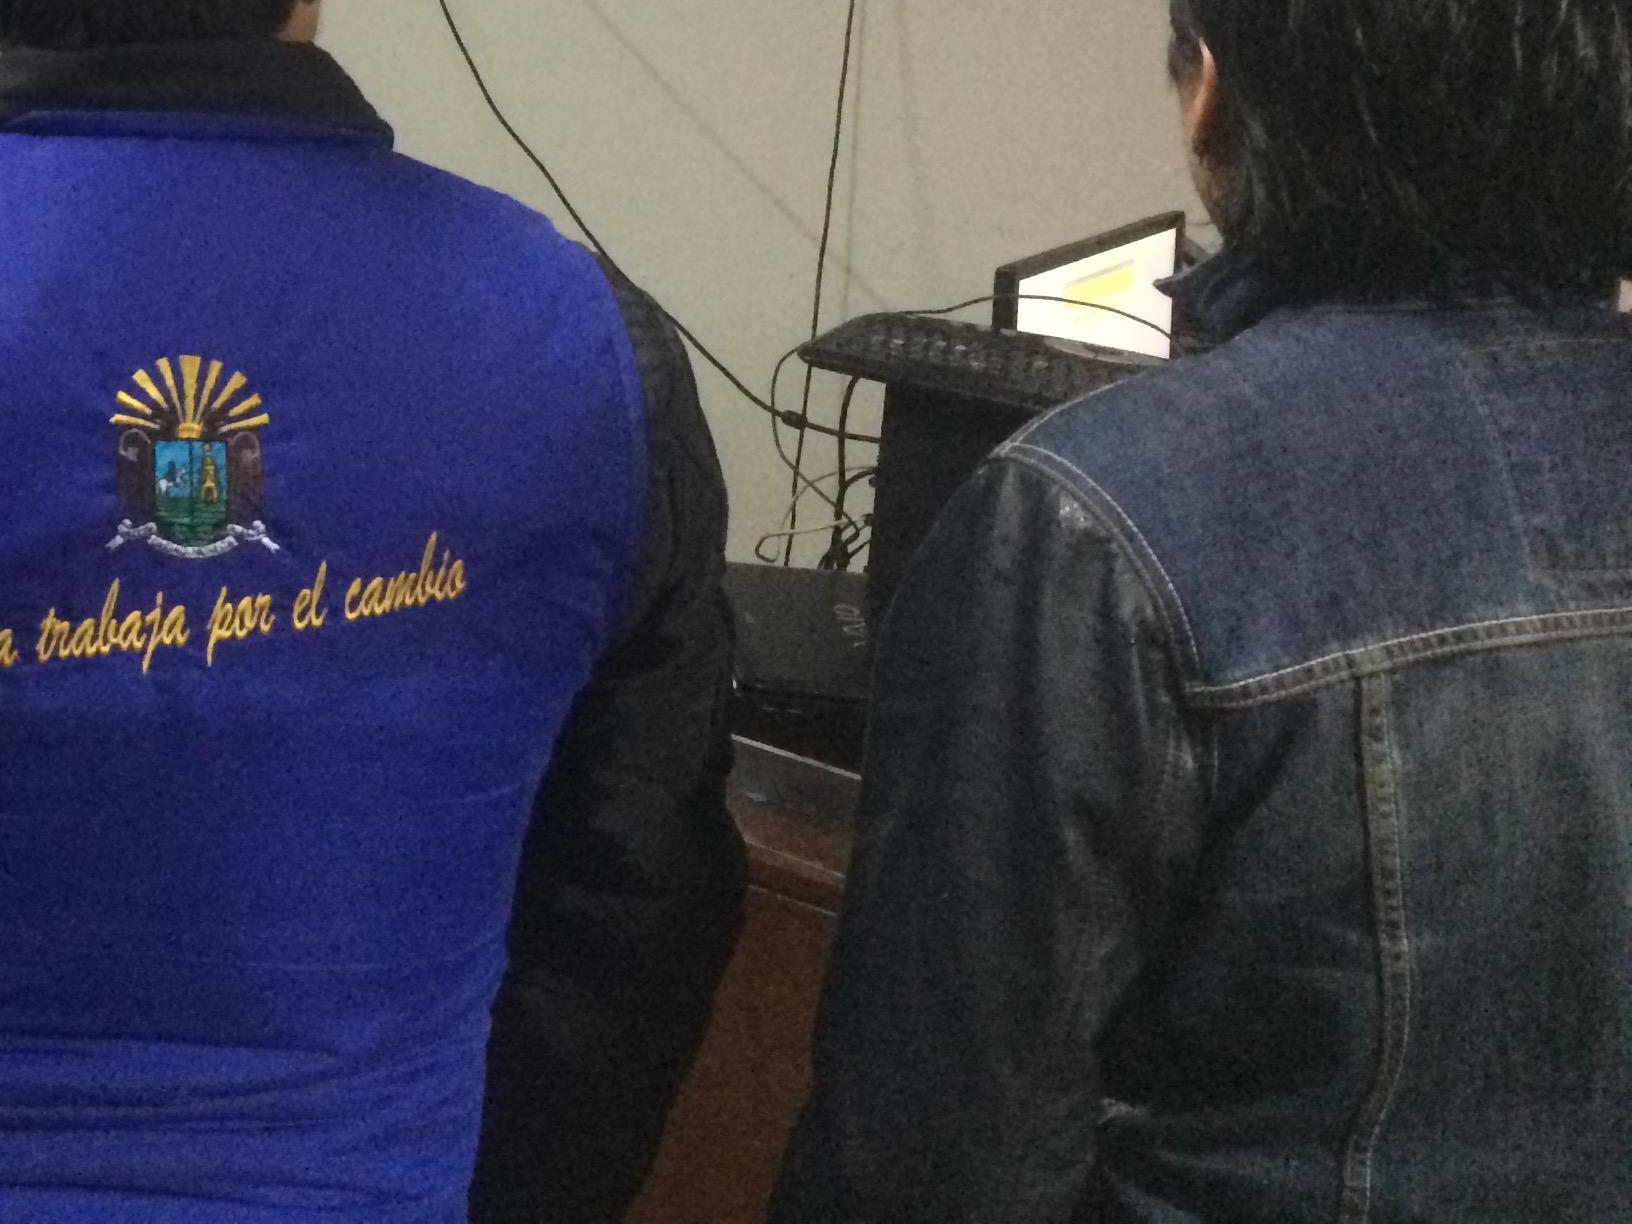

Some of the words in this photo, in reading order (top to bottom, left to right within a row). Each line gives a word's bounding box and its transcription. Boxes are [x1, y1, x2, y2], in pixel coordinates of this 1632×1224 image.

[35, 577, 190, 676] trabaja
[206, 584, 276, 669] por
[291, 561, 329, 632] el
[344, 530, 467, 620] cambio
